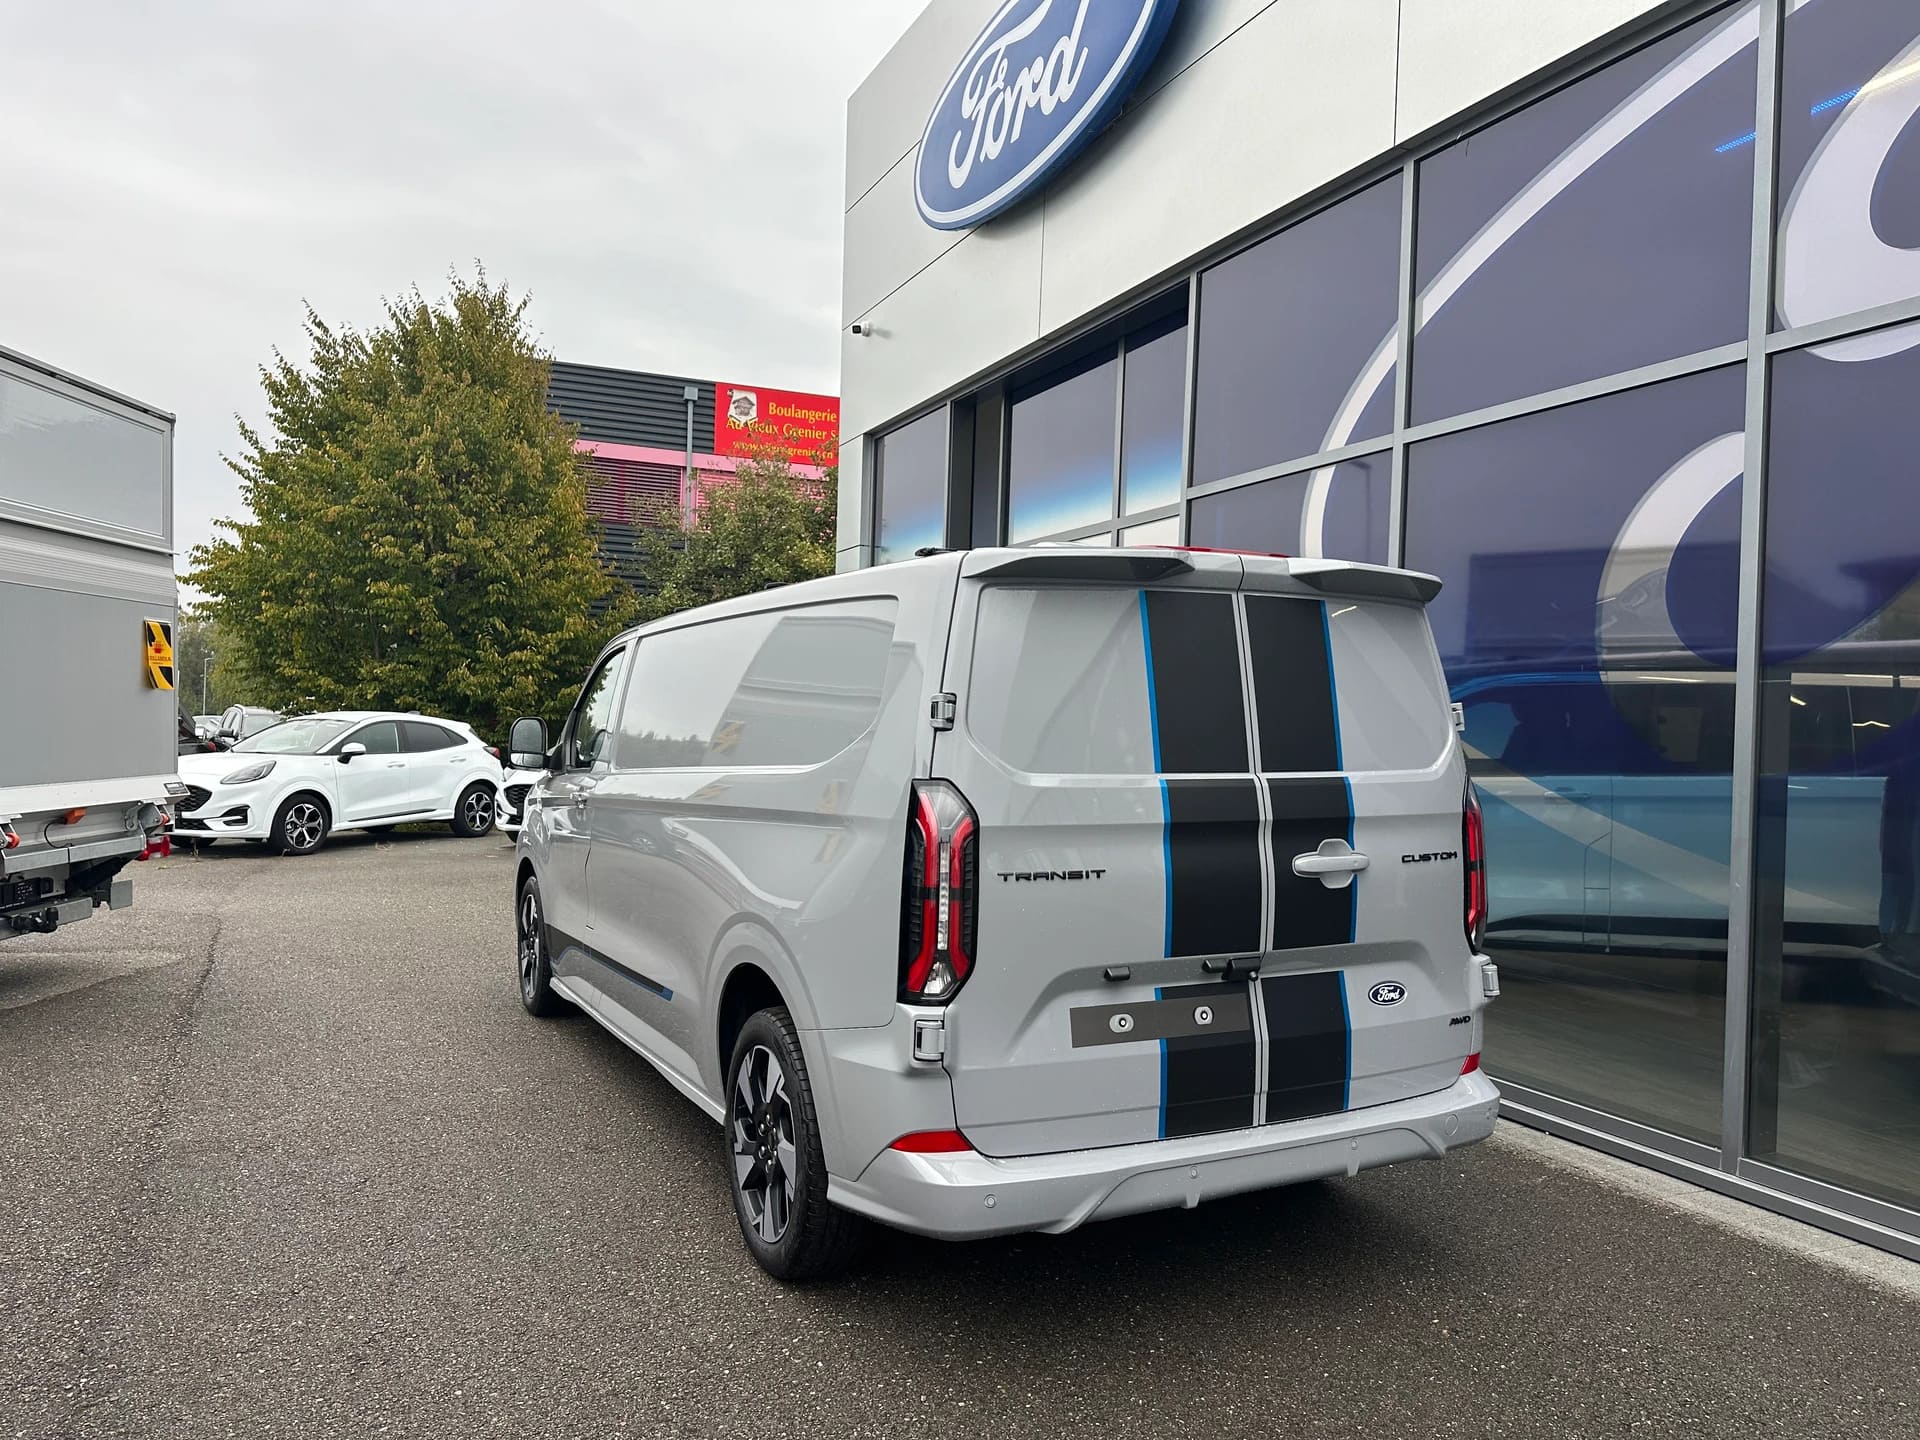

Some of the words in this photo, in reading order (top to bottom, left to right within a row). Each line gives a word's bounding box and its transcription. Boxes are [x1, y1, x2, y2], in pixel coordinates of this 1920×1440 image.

[948, 0, 1089, 188] Ford
[768, 402, 838, 423] Boulangerie
[726, 416, 743, 430] Au
[783, 423, 827, 440] Grenier
[1402, 851, 1458, 863] CUSTOM
[997, 869, 1106, 882] TRANSIT
[1377, 986, 1401, 1001] Ford
[1449, 1015, 1471, 1026] AWD
